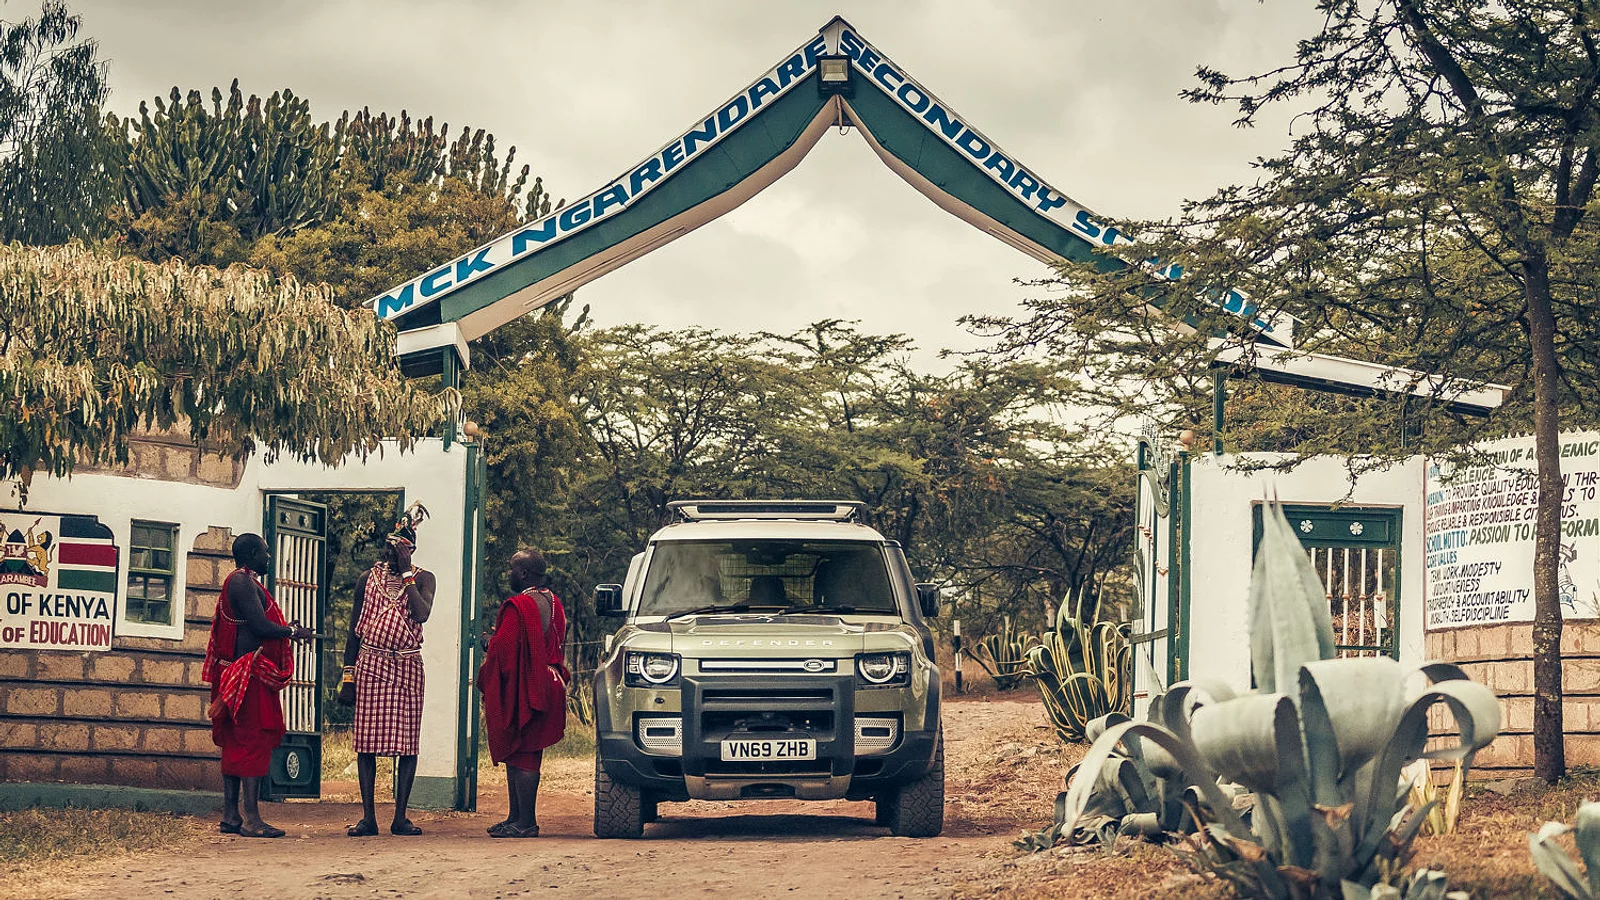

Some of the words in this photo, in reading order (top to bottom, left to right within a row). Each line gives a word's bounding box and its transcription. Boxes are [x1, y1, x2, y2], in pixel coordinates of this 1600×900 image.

[839, 29, 1067, 212] SECONDARY
[377, 247, 496, 320] MCK
[512, 34, 828, 257] NGARENDARE
[1510, 448, 1523, 462] OF
[1525, 441, 1599, 461] AEMIC
[1451, 498, 1481, 514] IMPARTING
[1481, 492, 1529, 510] KNOWLEDGE
[1530, 491, 1537, 505] &
[1580, 486, 1595, 501] TO
[1453, 483, 1480, 499] PROVIDE
[1480, 479, 1515, 497] QUALITY
[1462, 514, 1467, 527] &
[1469, 508, 1521, 526] RESPONSIBLE
[1426, 534, 1443, 553] SCHOOL
[1443, 530, 1468, 549] MOTTO:
[1469, 524, 1511, 546] PASSION
[1514, 523, 1529, 542] TO
[1460, 561, 1502, 579] MODESTY
[7, 592, 32, 615] OF
[39, 594, 110, 619] KENYA
[1461, 588, 1530, 608] ACCOUNTABILITY
[2, 627, 25, 643] OF
[30, 620, 110, 647] EDUCATION
[729, 742, 772, 757] VN69
[776, 741, 809, 757] ZHB
